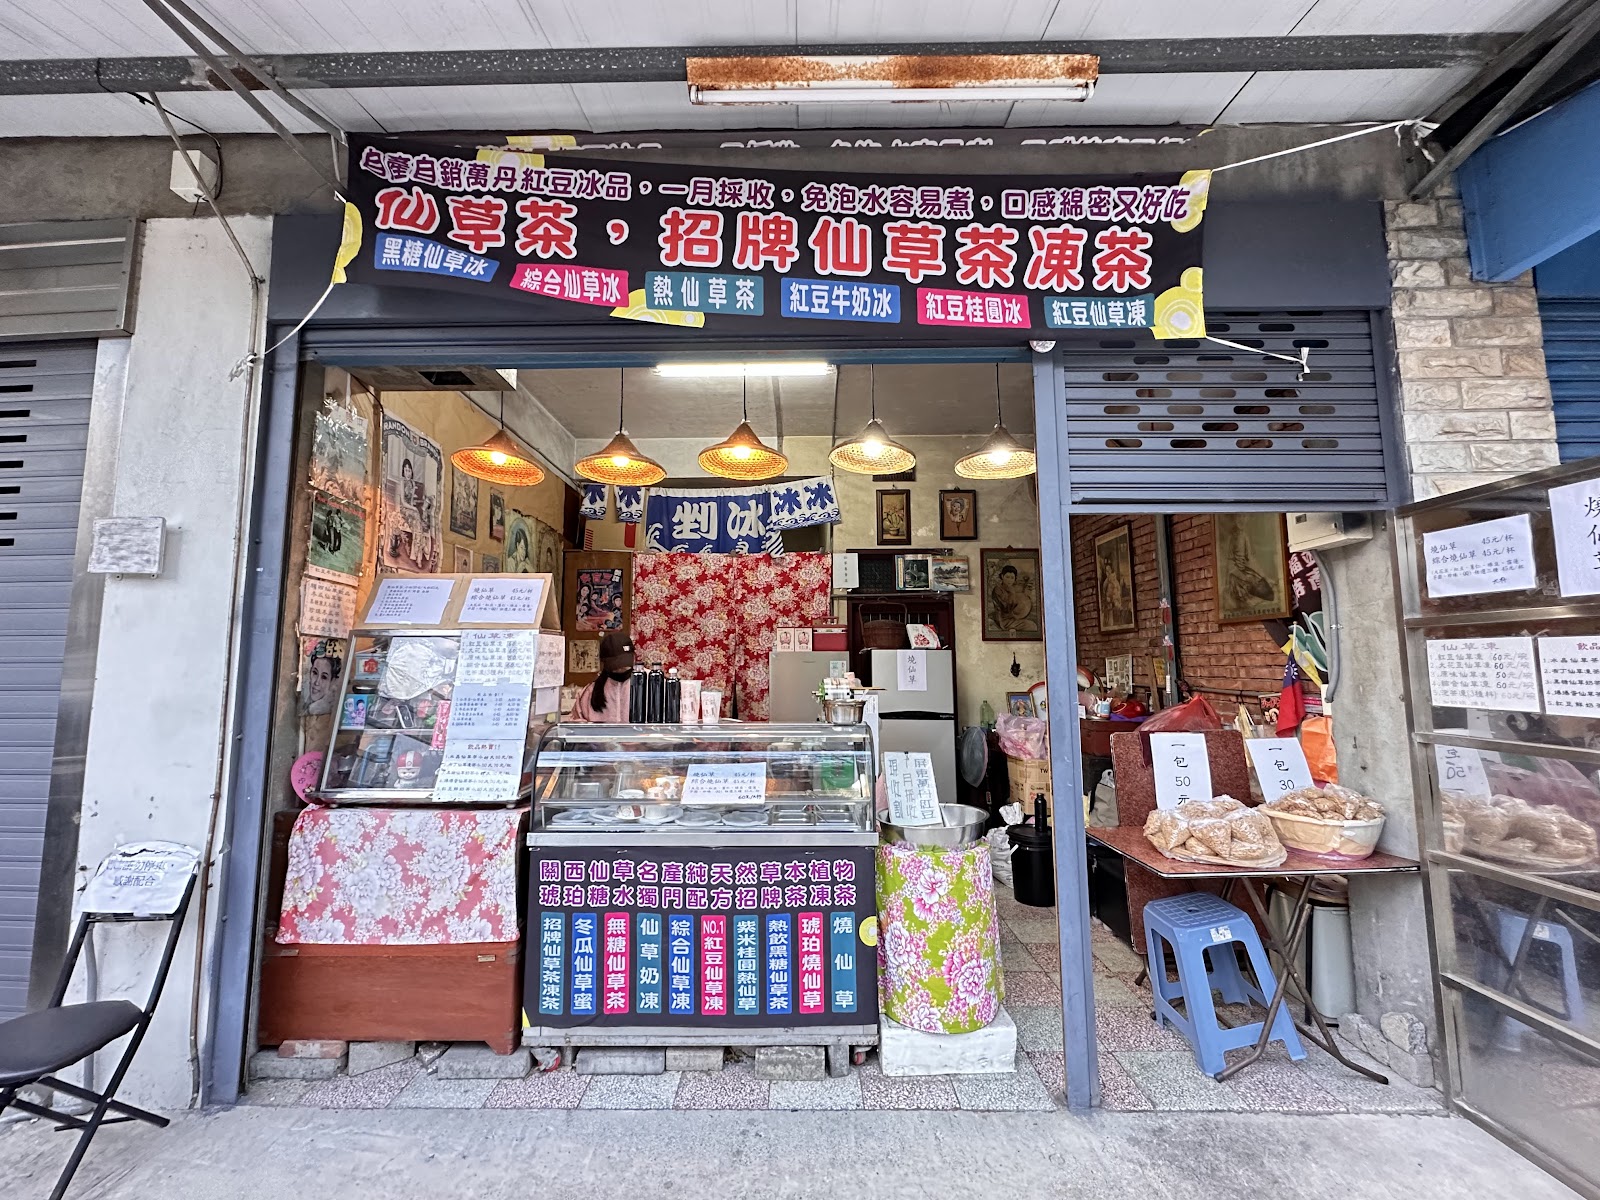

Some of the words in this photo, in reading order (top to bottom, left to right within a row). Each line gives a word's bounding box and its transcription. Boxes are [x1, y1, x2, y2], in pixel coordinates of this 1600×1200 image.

[381, 236, 488, 277] 黑糖仙草冰
[520, 268, 621, 303] 綜合仙草冰
[652, 276, 756, 311] 熱仙草茶
[789, 283, 892, 317] 紅豆牛奶冰
[925, 293, 1022, 325] 紅豆桂圓冰
[1052, 300, 1147, 327] 紅豆仙草凍
[1430, 542, 1457, 554] 燒仙草
[1481, 534, 1514, 545] 45元/杯
[1432, 550, 1476, 564] 綜合燒仙草
[1482, 547, 1515, 557] 45元/杯
[1441, 642, 1500, 651] 仙草凍
[907, 655, 917, 684] 燒仙草
[540, 859, 856, 884] 關西仙草名產純天然草本植物
[539, 884, 857, 909] 琥珀糖水獨門配方招牌茶凍茶
[542, 917, 562, 1011] 招牌仙草茶凍茶
[574, 917, 593, 1011] 冬瓜仙草蜜
[606, 917, 626, 1010] 無糖仙草茶
[640, 917, 659, 1009] 仙草奶凍
[671, 919, 691, 1010] 綜合仙草凍
[769, 919, 789, 1010] 熱飲黑糖仙草茶
[801, 917, 821, 1009] 琥珀燒仙草
[833, 916, 854, 1008] 燒仙草
